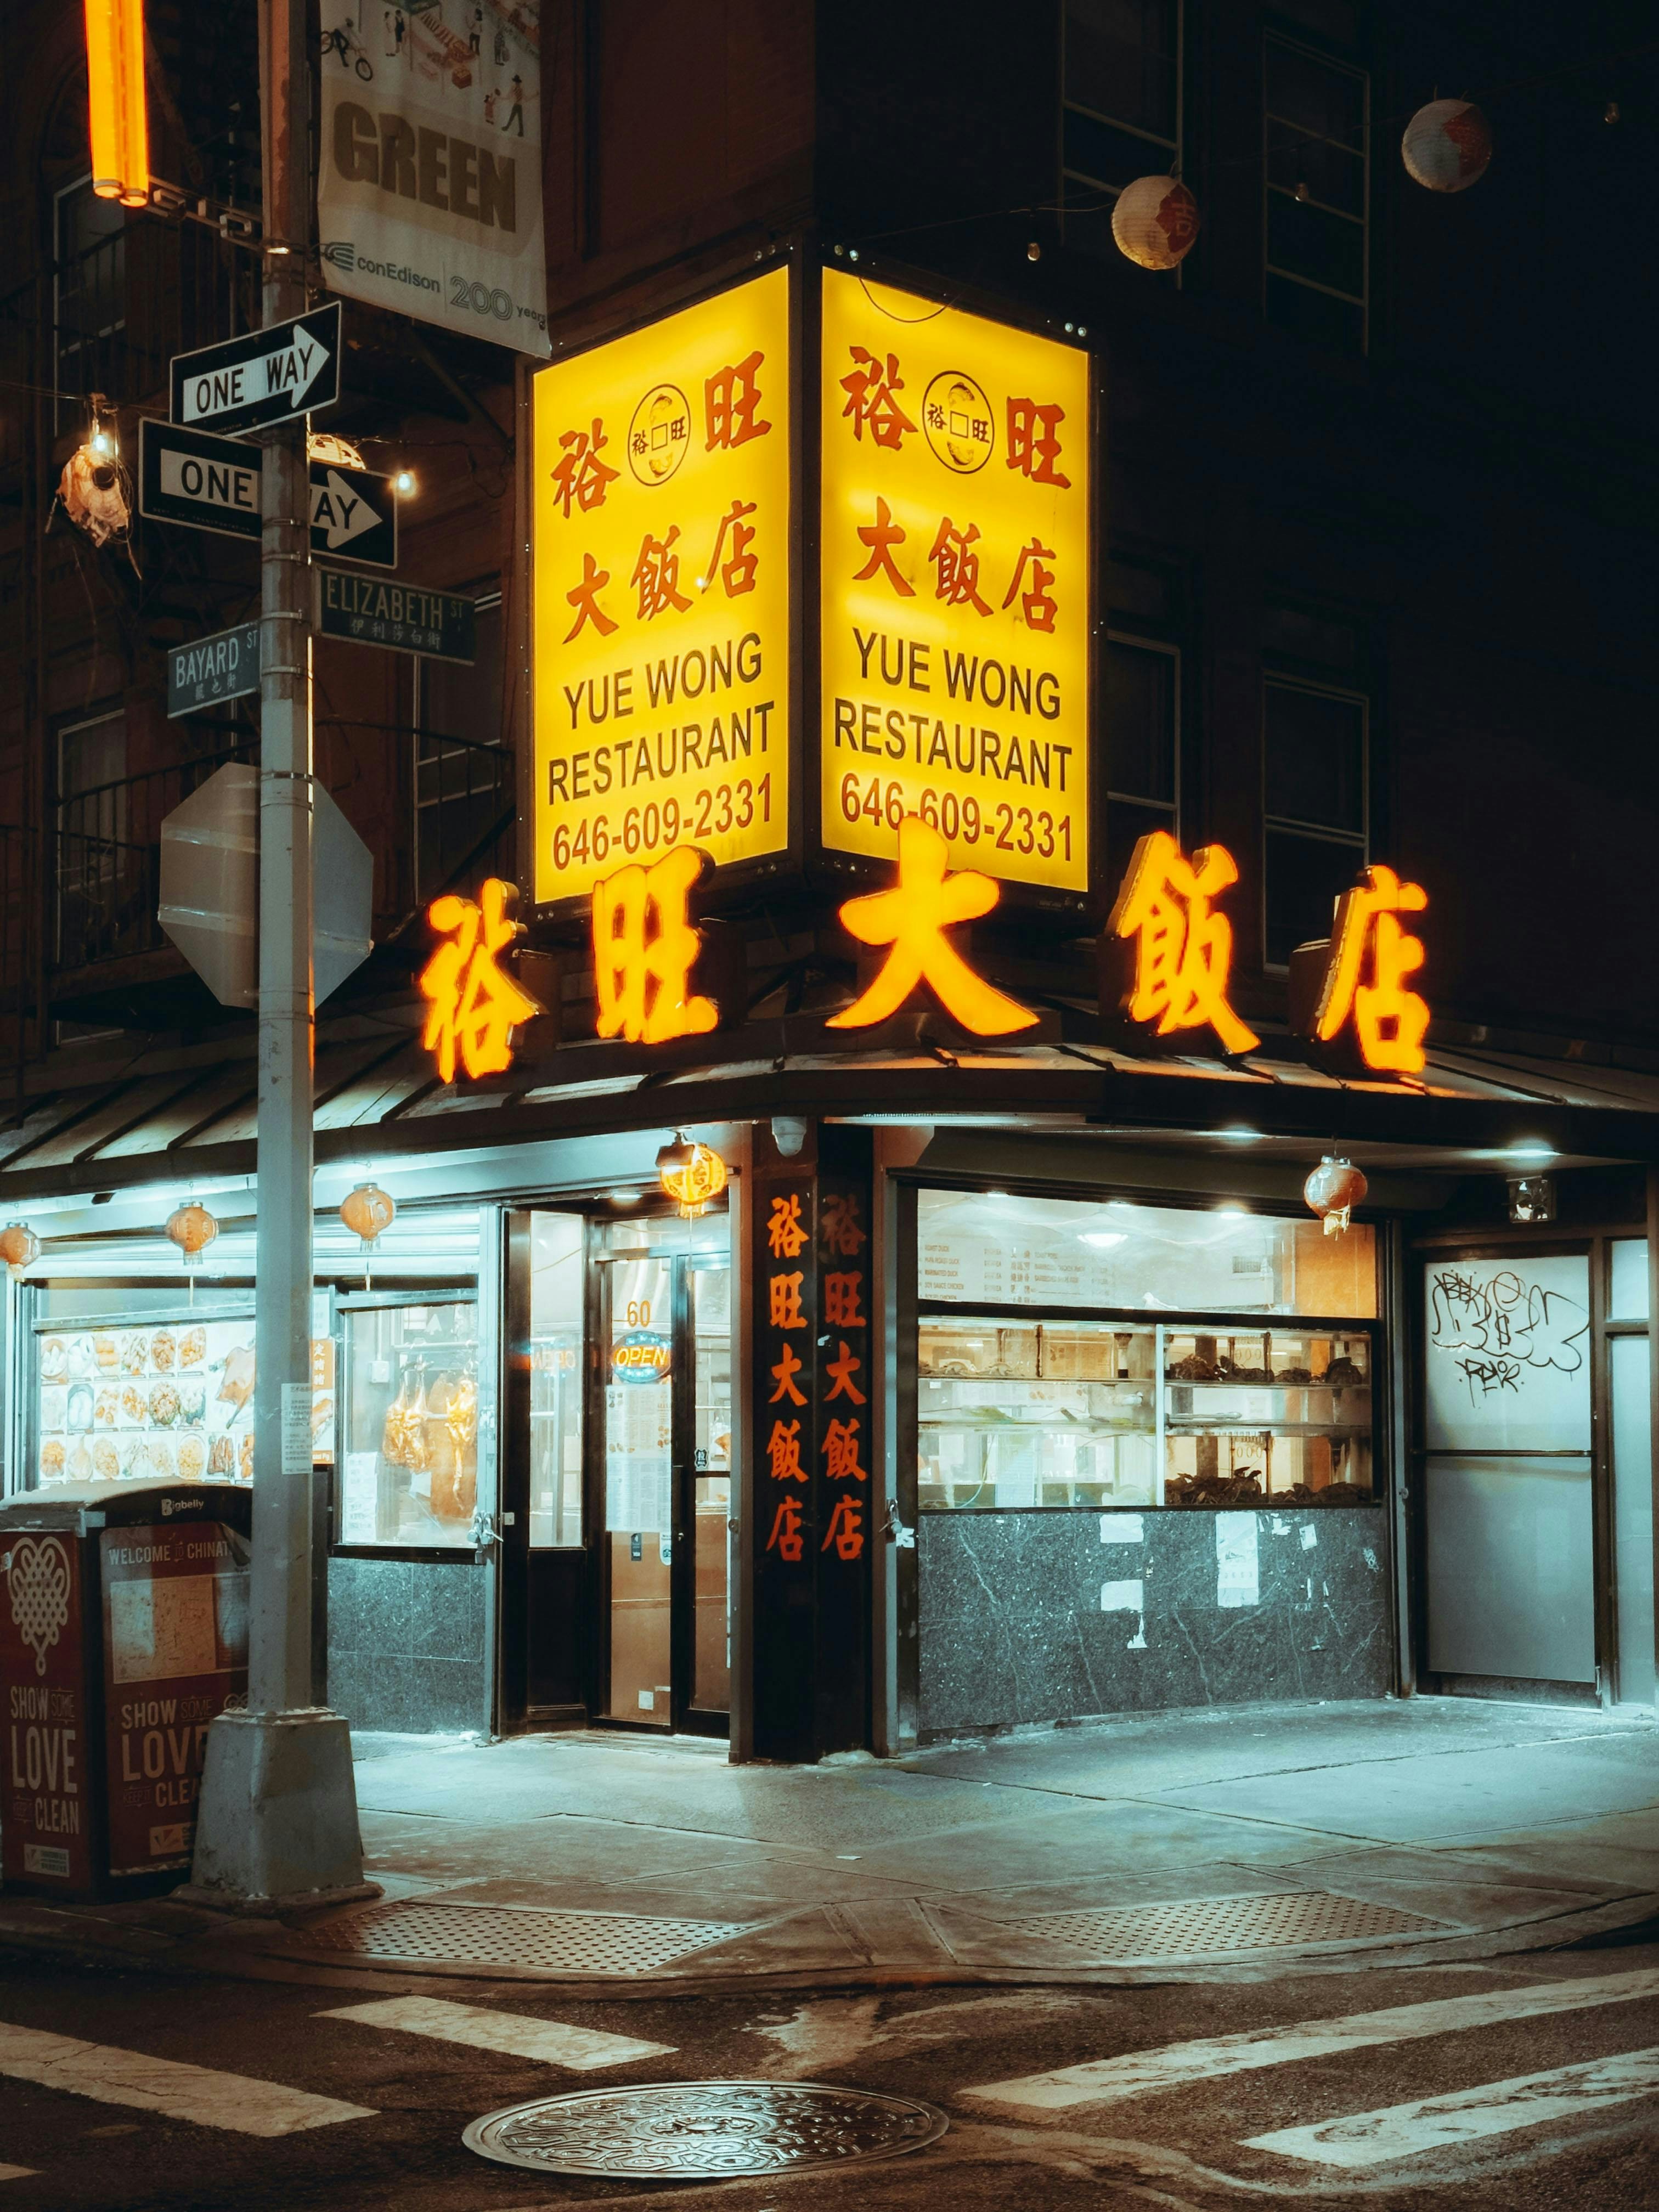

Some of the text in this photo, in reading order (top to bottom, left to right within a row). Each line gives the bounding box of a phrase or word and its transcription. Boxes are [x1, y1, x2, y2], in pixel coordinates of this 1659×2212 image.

[333, 101, 517, 234] GREEN
[357, 256, 441, 294] conEdison
[450, 275, 514, 321] 200
[196, 343, 315, 415] ONE WAY
[838, 345, 1072, 489] 裕 旺
[550, 350, 772, 519] 裕 旺
[181, 460, 359, 531] ONE AY
[326, 574, 466, 630] ELIZABETH ST
[562, 499, 759, 645] 大飯店
[851, 495, 1059, 634] 大飯店
[176, 629, 258, 689] BAYARD ST
[563, 631, 761, 730] YUE WONG
[852, 626, 1061, 720] YUE WONG
[549, 700, 775, 806] RESTAURANT
[834, 697, 1073, 792] RESTAURANT
[552, 772, 771, 871] 646-609-2331
[840, 771, 1071, 862] 646-609-2331
[419, 814, 1431, 1084] 裕旺大飯店
[627, 1300, 651, 1328] 60
[615, 1345, 668, 1368] OPEN
[766, 1193, 809, 1562] 裕旺大飯店
[821, 1193, 868, 1562] 裕旺大飯店
[161, 1498, 204, 1516] Bigbelly
[108, 1544, 171, 1566] WELCOME
[187, 1540, 230, 1560] CHINAT
[10, 1685, 75, 1721] SHOW SOME
[121, 1699, 213, 1730] SHOW SOME
[10, 1725, 78, 1794] LOVE
[35, 1796, 80, 1835] CLEAN
